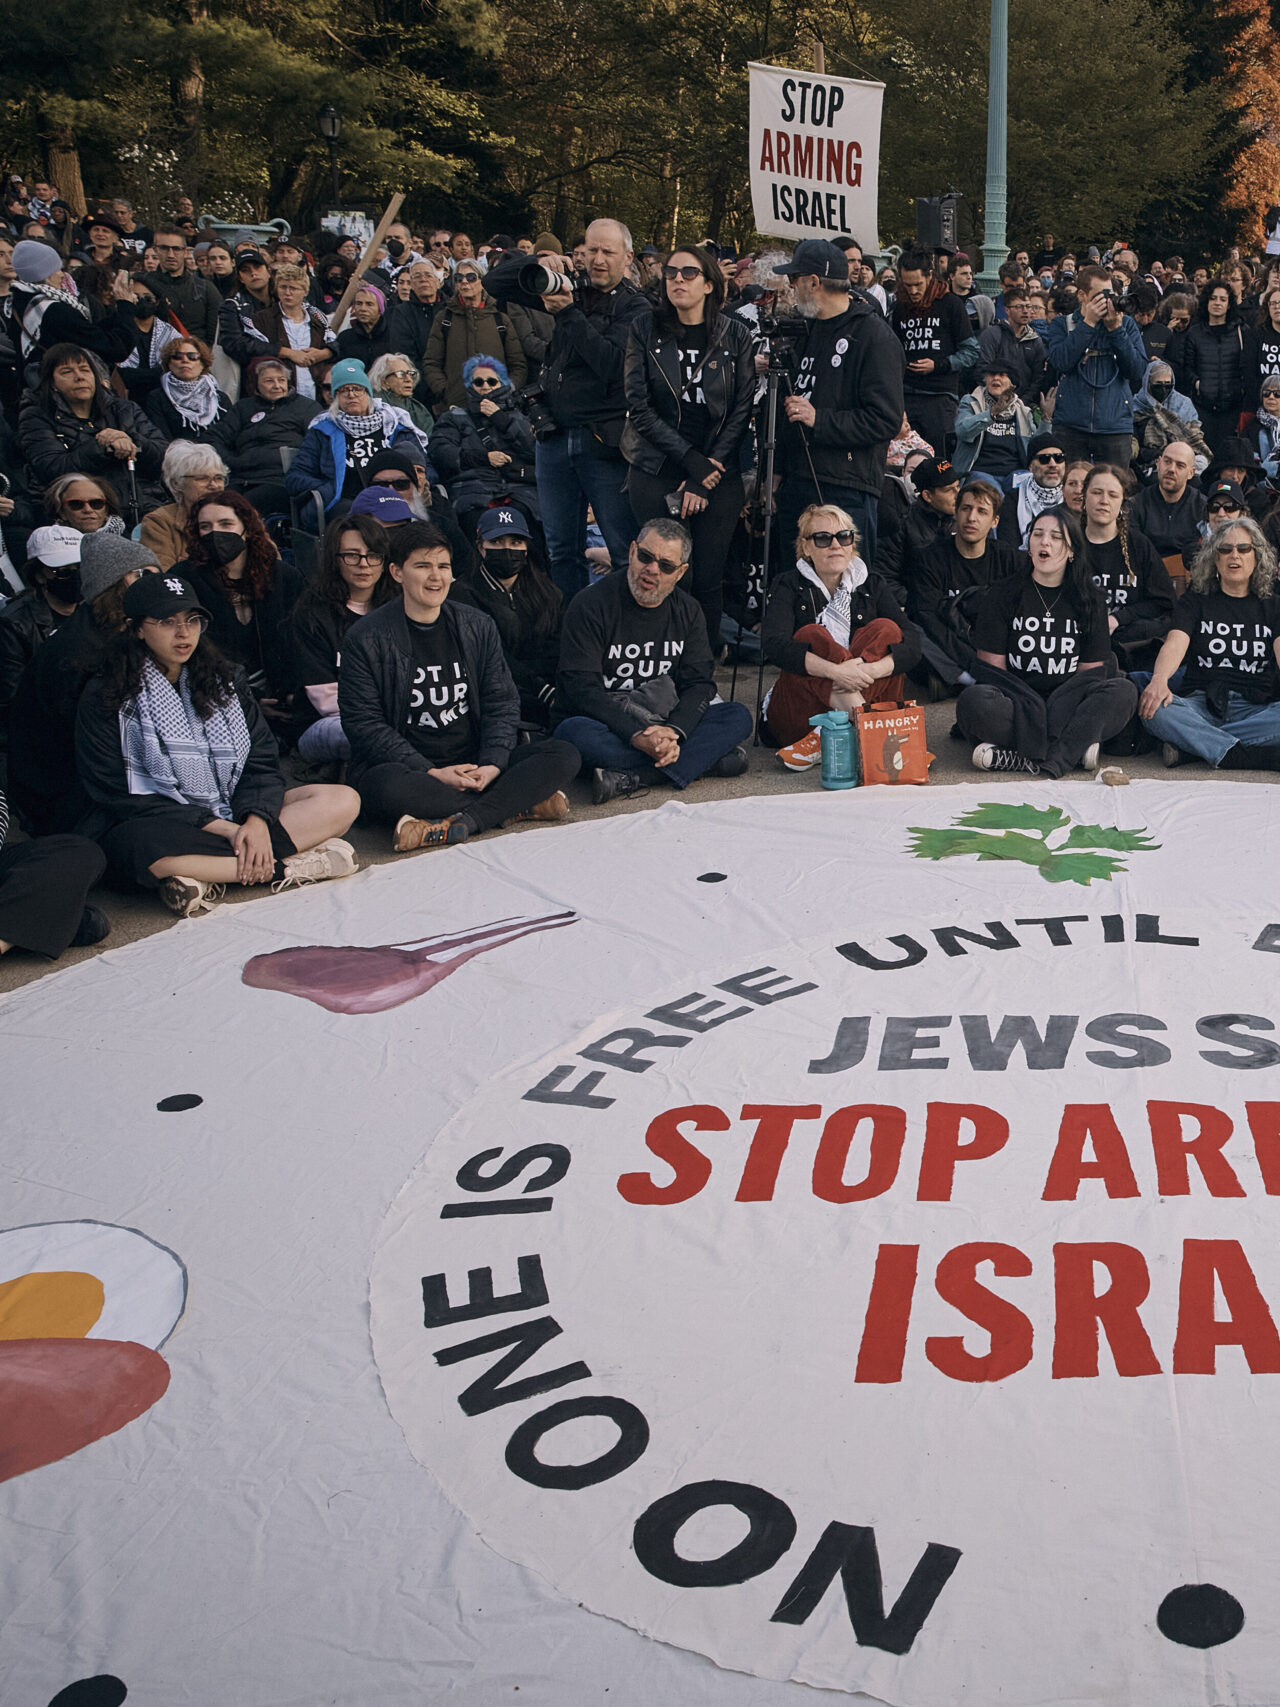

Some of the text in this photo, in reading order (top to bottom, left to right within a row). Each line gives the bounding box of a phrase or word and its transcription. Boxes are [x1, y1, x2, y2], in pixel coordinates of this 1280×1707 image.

[781, 78, 844, 128] STOP
[760, 128, 862, 187] ARMING
[771, 183, 852, 233] ISRAEL
[906, 328, 933, 339] OUR
[927, 317, 940, 326] IN
[1012, 616, 1055, 632] NOT
[1200, 621, 1245, 637] NOT
[608, 640, 684, 659] NOT IN
[1018, 635, 1076, 654] OUR
[1208, 638, 1266, 657] OUR
[616, 660, 672, 677] OUR
[1008, 653, 1079, 675] NAME
[407, 700, 469, 728] AME
[864, 715, 919, 730] HANGRY
[835, 914, 1200, 970] UNTIL
[521, 967, 820, 1109] FREE
[808, 1013, 1172, 1073] JEWS
[618, 1102, 1008, 1204] STOP
[440, 1143, 572, 1219] IS
[421, 1254, 649, 1490] ONE
[633, 1479, 963, 1656] NO
